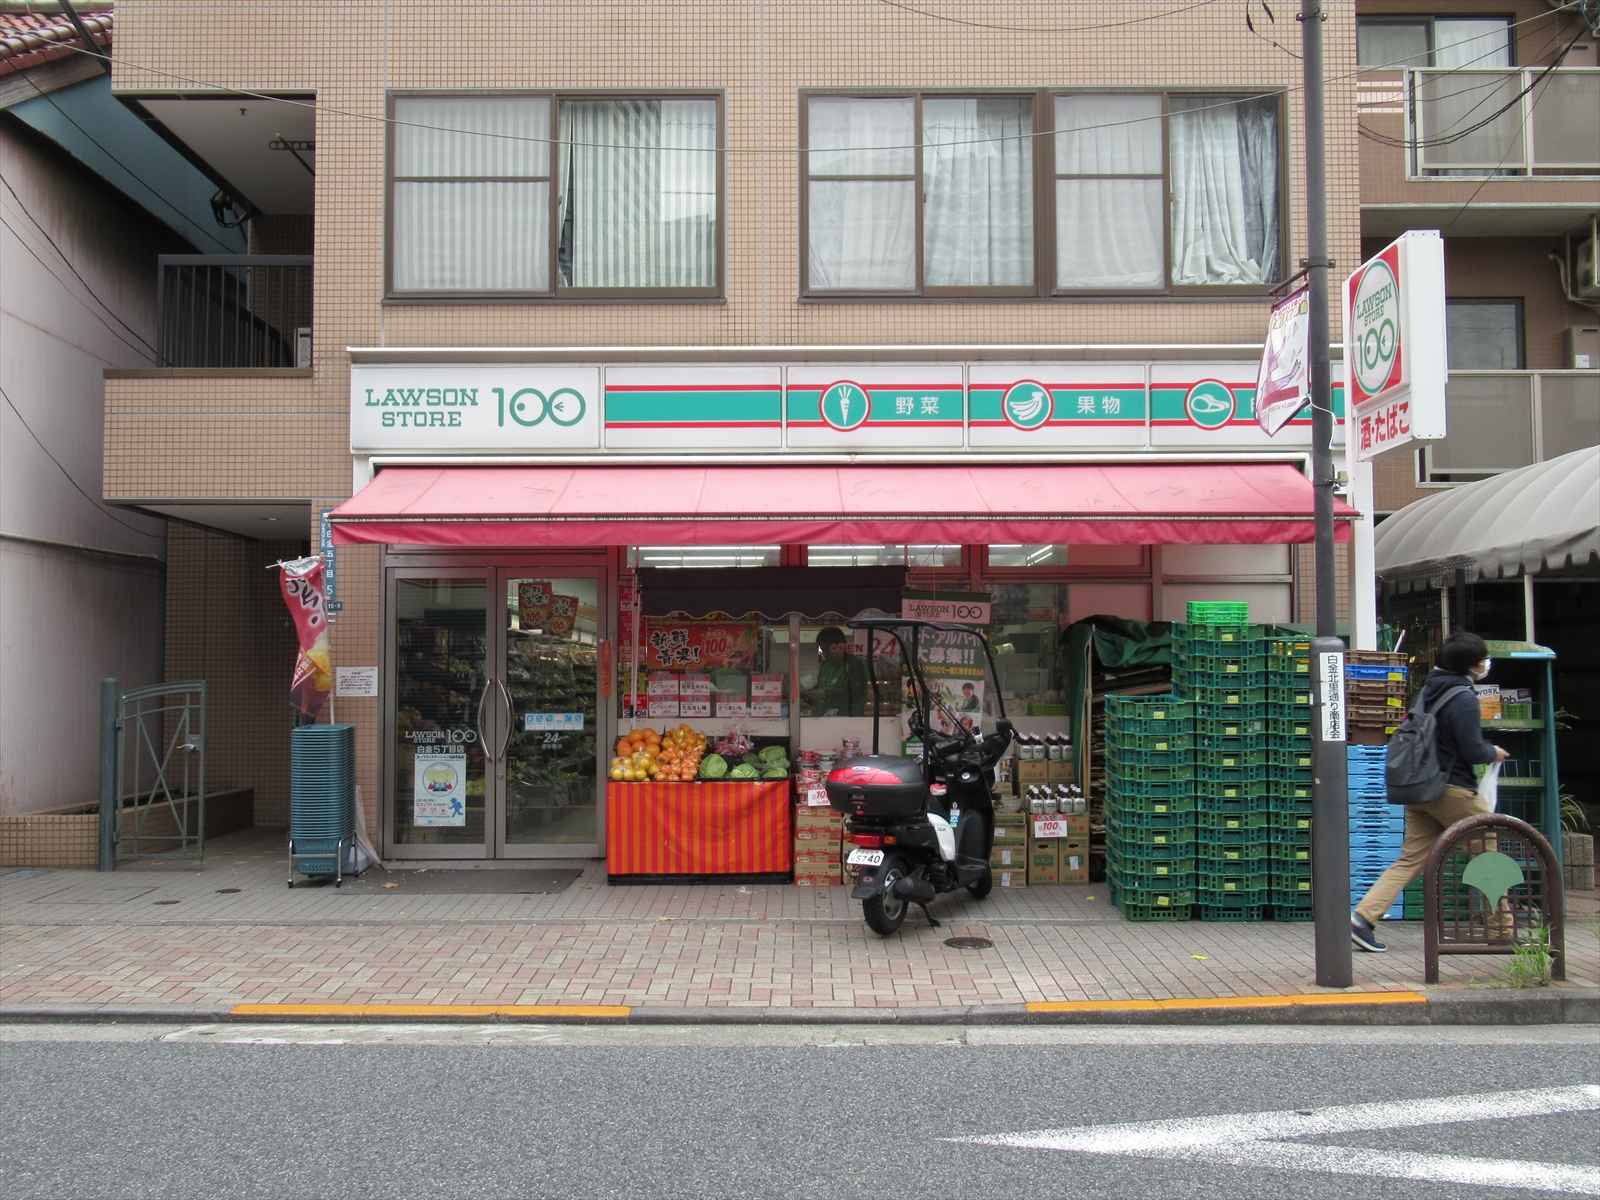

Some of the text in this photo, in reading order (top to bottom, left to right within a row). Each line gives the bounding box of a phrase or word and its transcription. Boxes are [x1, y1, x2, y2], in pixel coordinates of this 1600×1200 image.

[1356, 282, 1392, 319] LAWSON
[1364, 305, 1385, 327] STORE
[1356, 318, 1395, 376] 100
[365, 387, 586, 428] LAWSON 100
[895, 396, 940, 416] 野菜
[1076, 395, 1120, 415] 果物
[381, 411, 462, 428] STORE
[1360, 401, 1410, 450] 酒・たばこ
[326, 585, 333, 595] 5
[909, 604, 983, 619] LAWSON 100
[650, 629, 690, 648] 新鮮
[657, 647, 701, 667] 青果!
[829, 644, 863, 653] OPEN
[865, 637, 898, 660] 24
[1327, 654, 1341, 739] 白金北里通り商店会
[405, 729, 477, 743] LAWSON 100
[543, 732, 560, 744] 24
[416, 745, 465, 754] 白金5丁目店
[1042, 822, 1059, 830] 100
[855, 854, 881, 864] 5740
